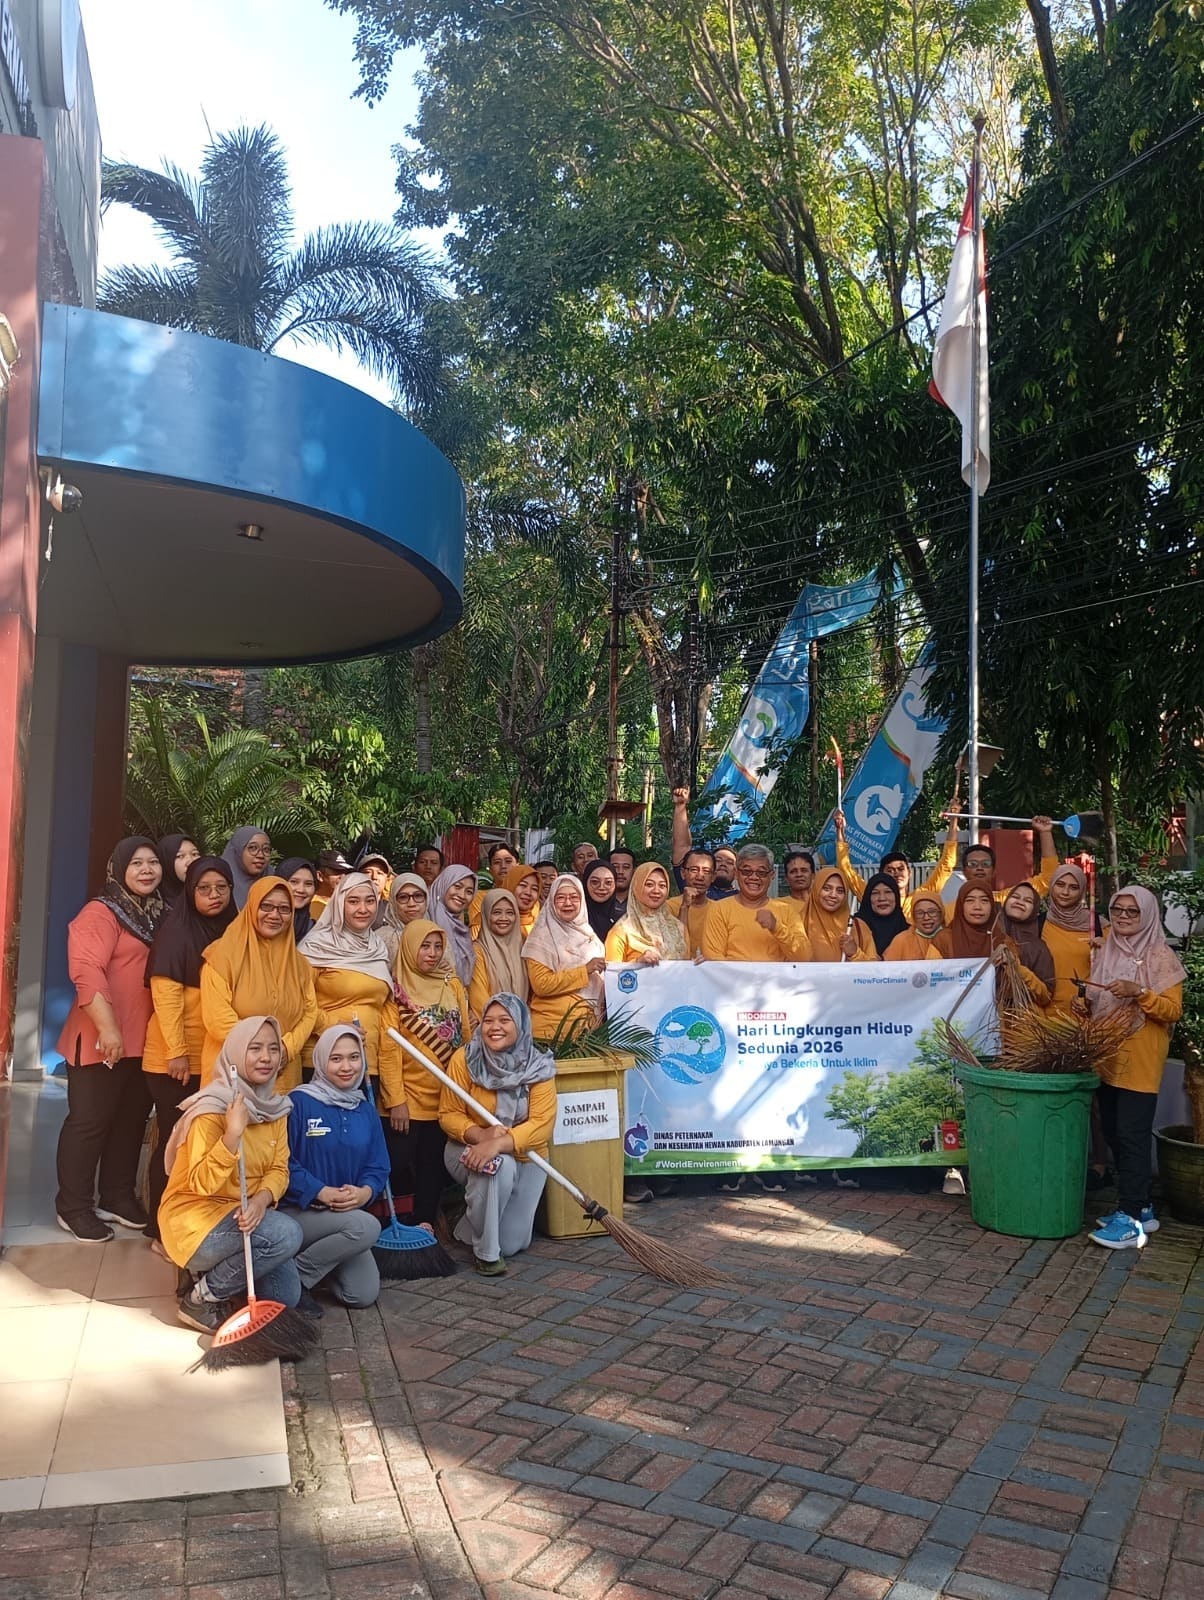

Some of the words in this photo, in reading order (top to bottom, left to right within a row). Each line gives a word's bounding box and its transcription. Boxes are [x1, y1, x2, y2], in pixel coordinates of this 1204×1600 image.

[959, 969, 972, 978] UN
[853, 977, 908, 985] #NowForClimate
[738, 1012, 786, 1021] INDONESIA
[737, 1024, 768, 1037] Hari
[773, 1023, 862, 1038] Lingkungan
[867, 1022, 913, 1037] Hidup
[737, 1042, 799, 1055] Sedunia
[803, 1041, 844, 1054] 2026
[821, 1057, 851, 1068] Untuk
[854, 1057, 878, 1067] Iklim
[564, 1101, 606, 1114] SAMPAH
[562, 1114, 609, 1127] ORGANIK
[653, 1131, 674, 1140] DINAS
[674, 1131, 714, 1140] PETERNAKAN
[653, 1142, 668, 1150] DAN
[668, 1141, 704, 1150] KESEHATAN
[704, 1140, 726, 1149] HEWAN
[726, 1139, 761, 1149] KABUPATEN
